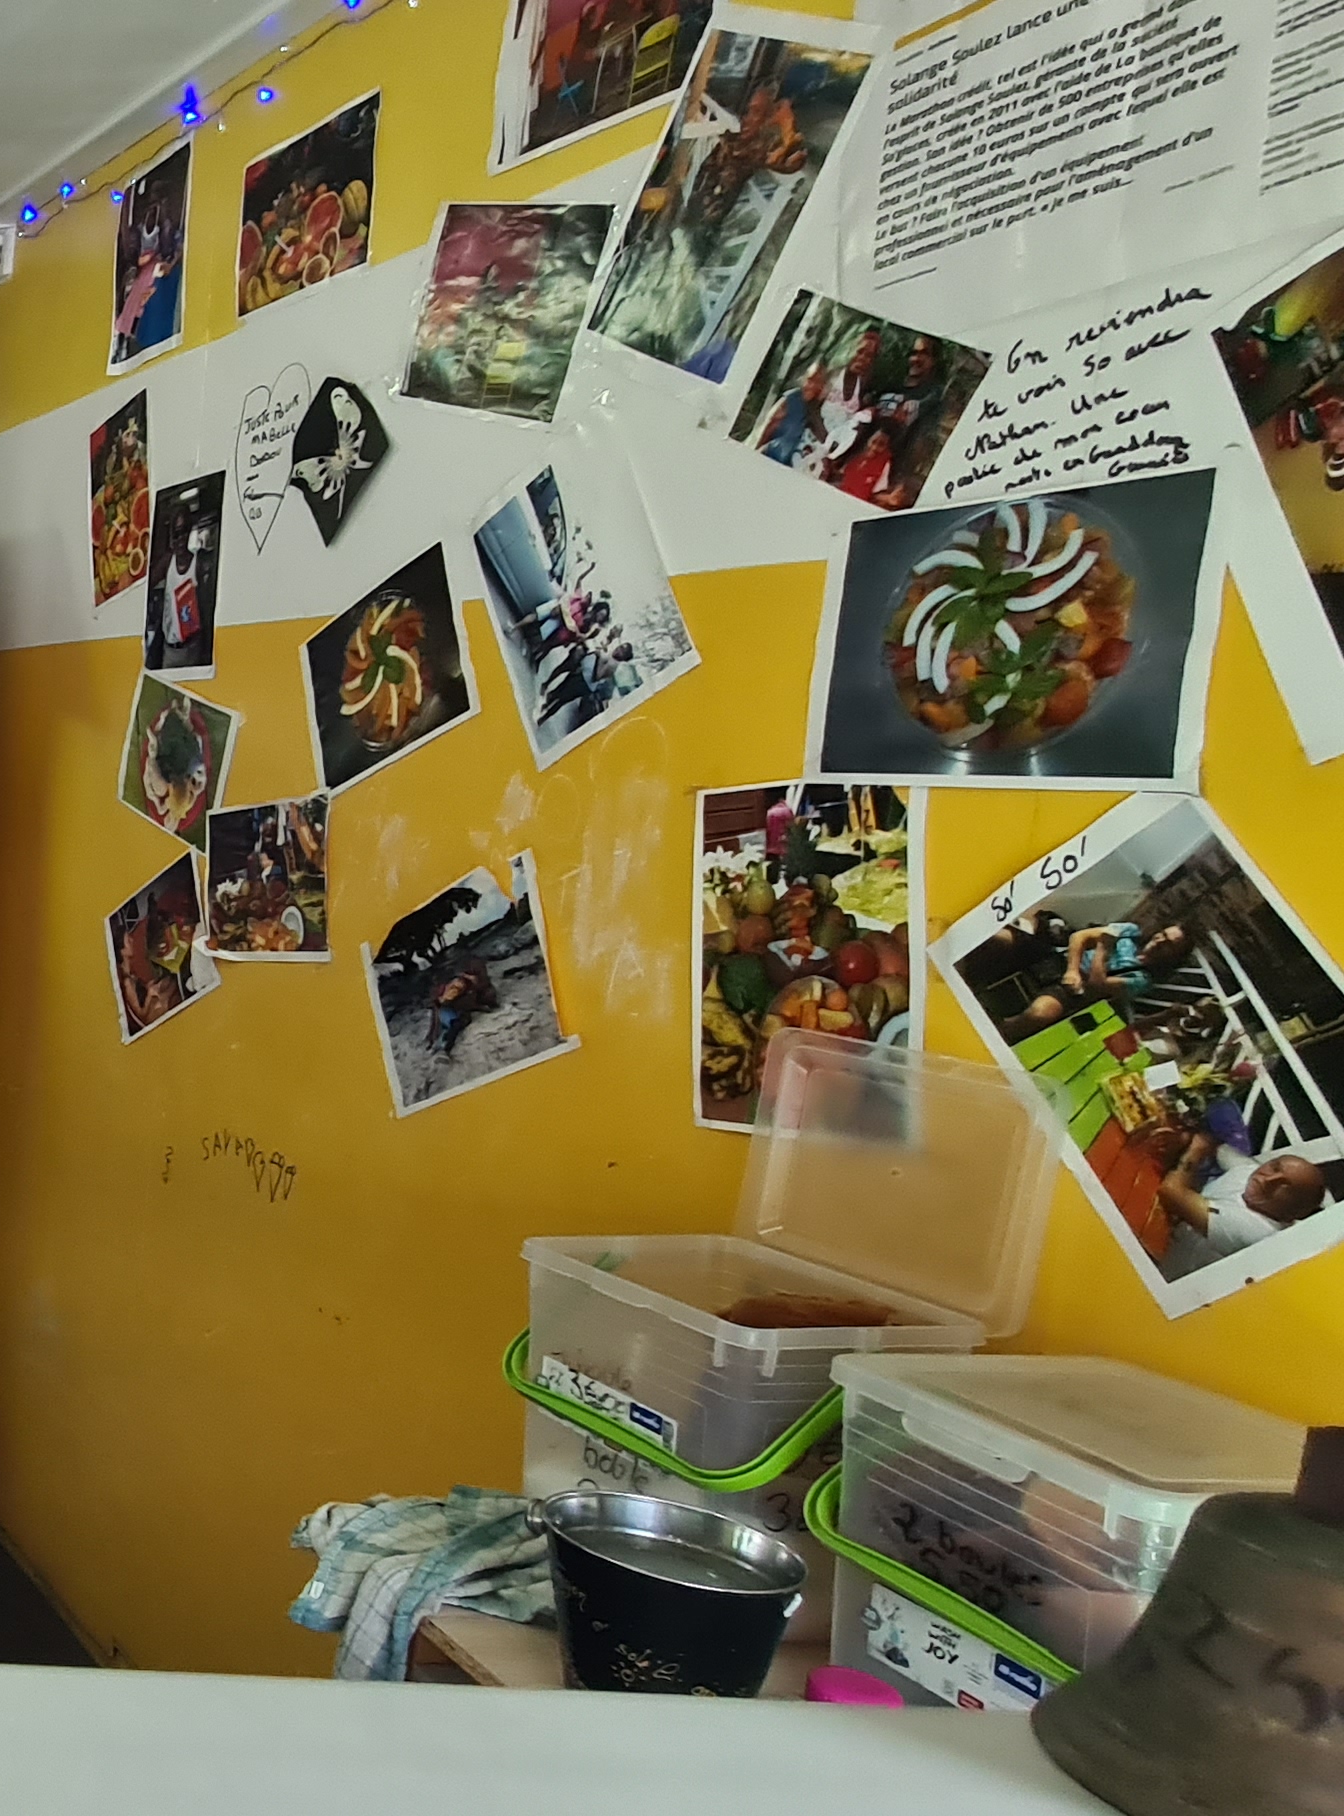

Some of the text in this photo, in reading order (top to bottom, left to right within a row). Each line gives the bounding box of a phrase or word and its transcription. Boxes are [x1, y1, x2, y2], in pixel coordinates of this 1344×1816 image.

[890, 10, 1052, 95] Solange Soulez lance
[988, 100, 1017, 120] 2011
[1094, 62, 1112, 77] de
[1202, 16, 1222, 32] de
[888, 71, 959, 115] solidarité
[989, 131, 1025, 150] euros
[924, 642, 959, 665] JOY
